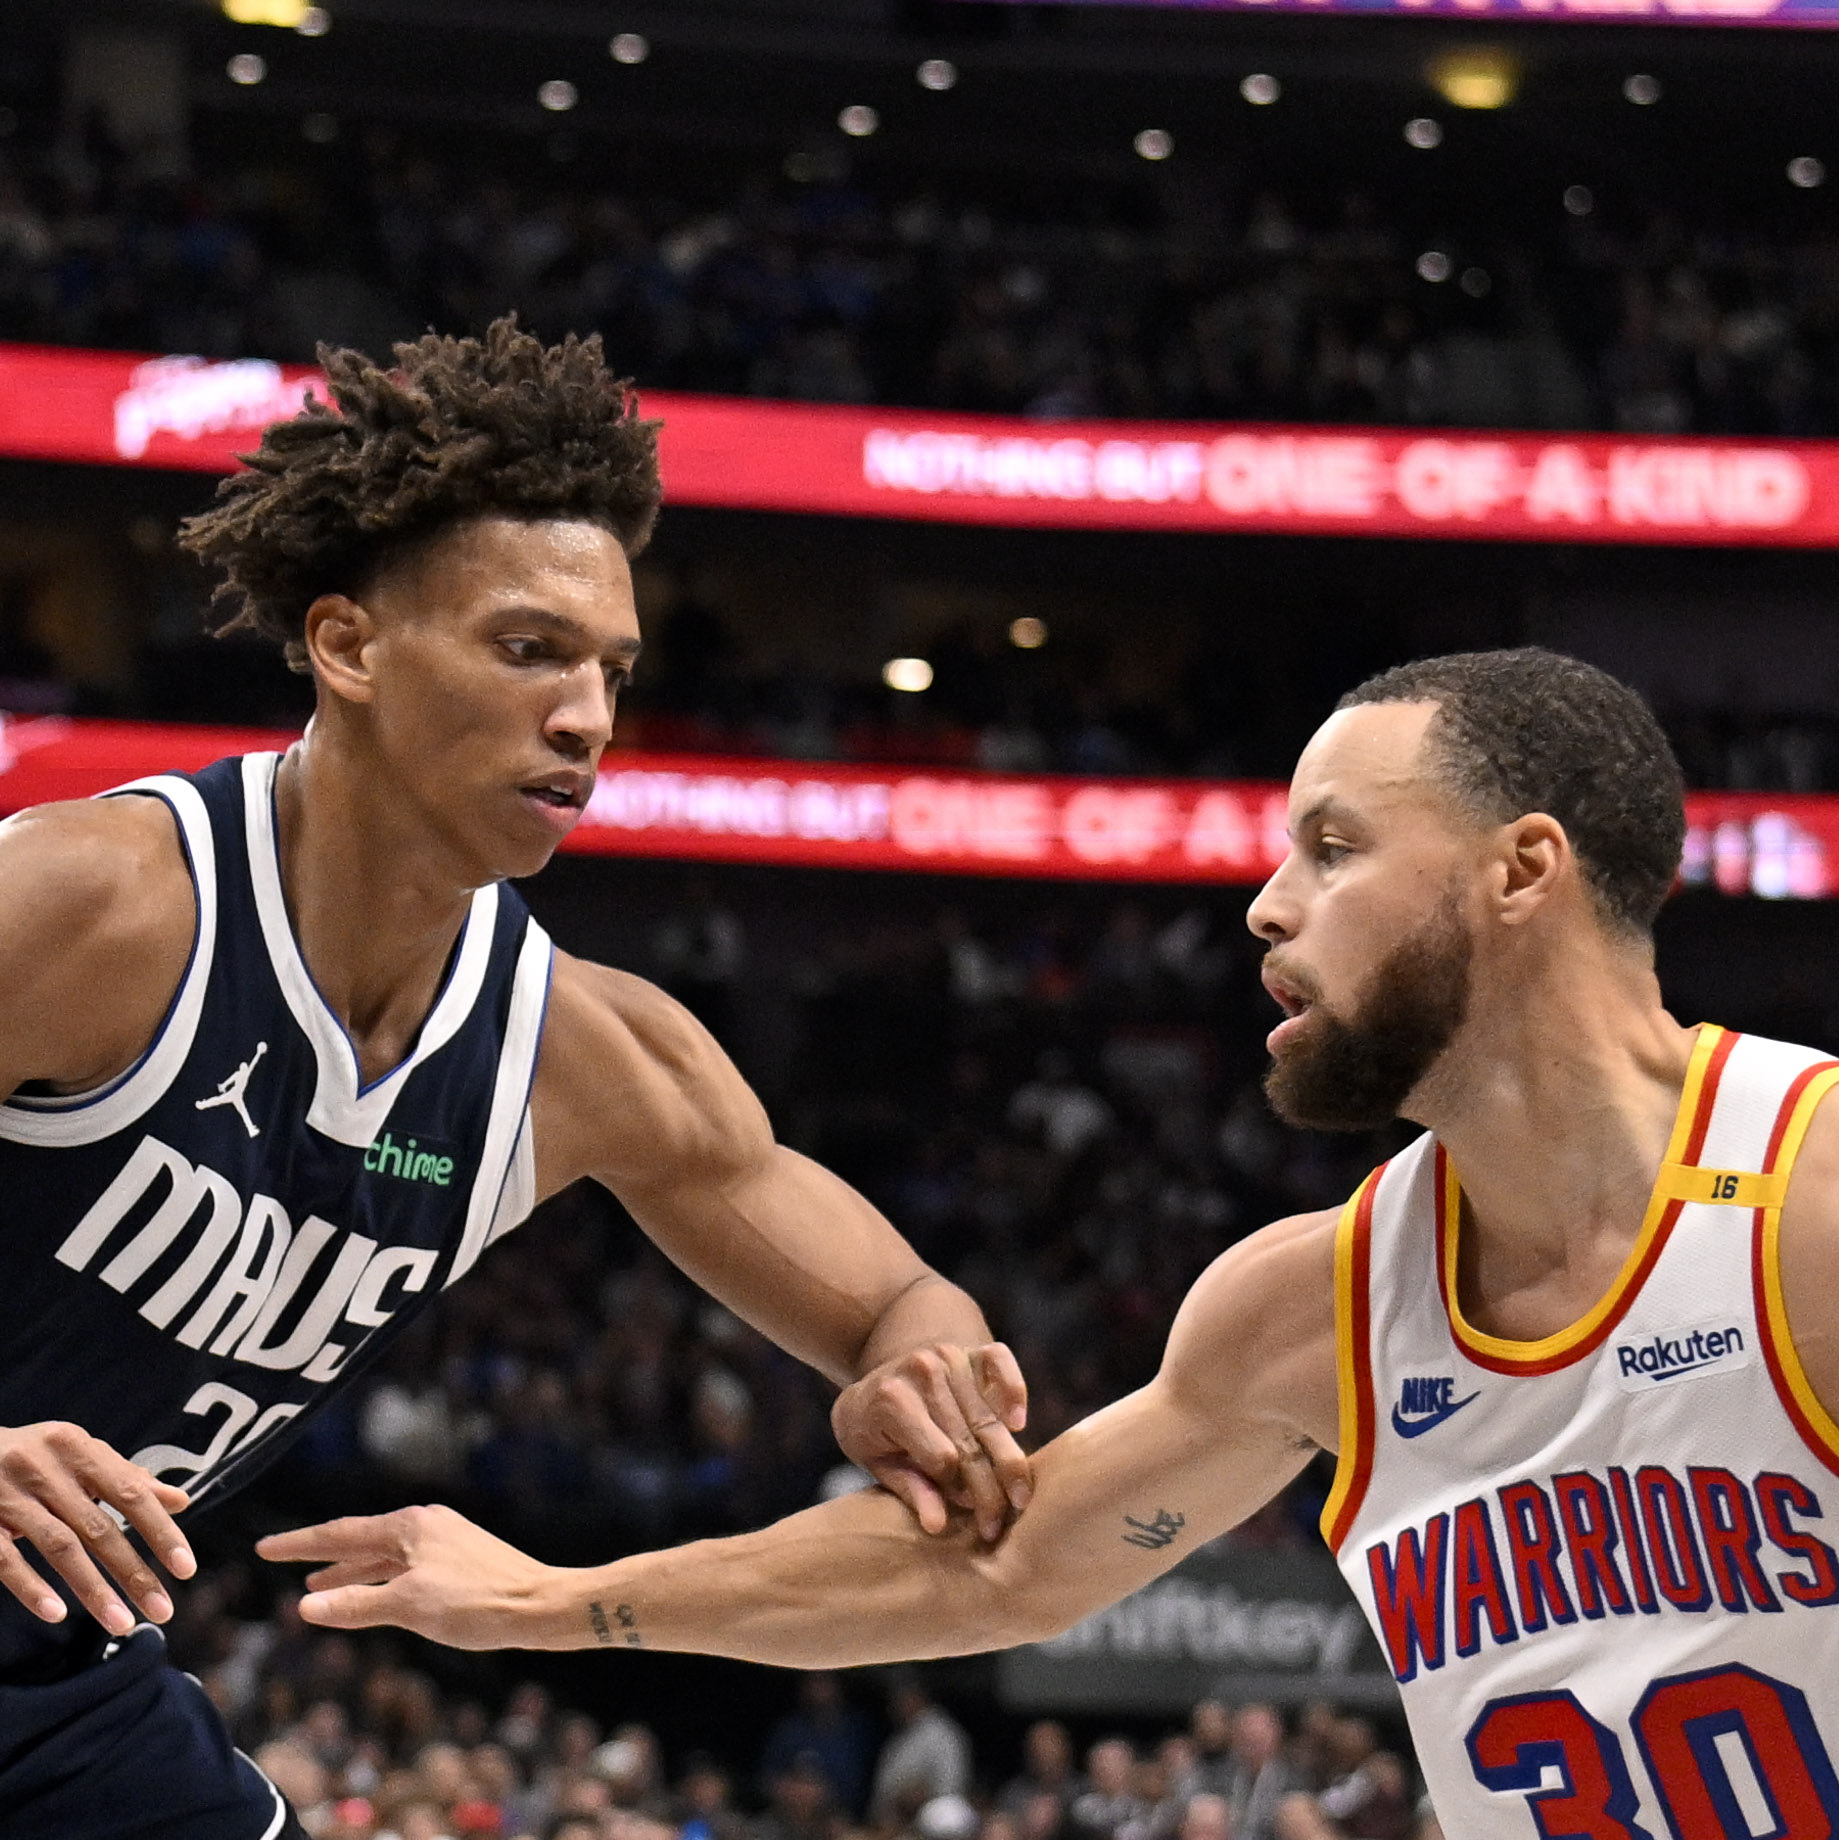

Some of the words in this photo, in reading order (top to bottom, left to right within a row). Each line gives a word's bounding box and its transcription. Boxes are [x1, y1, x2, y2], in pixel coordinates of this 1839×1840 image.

[863, 428, 1094, 501] NOTHING
[1095, 439, 1202, 504] BUT
[363, 1133, 454, 1187] chime
[1711, 1175, 1738, 1199] 16
[54, 1134, 439, 1382] MAVS
[1618, 1326, 1744, 1378] Rakuten
[1401, 1377, 1455, 1415] NIKE
